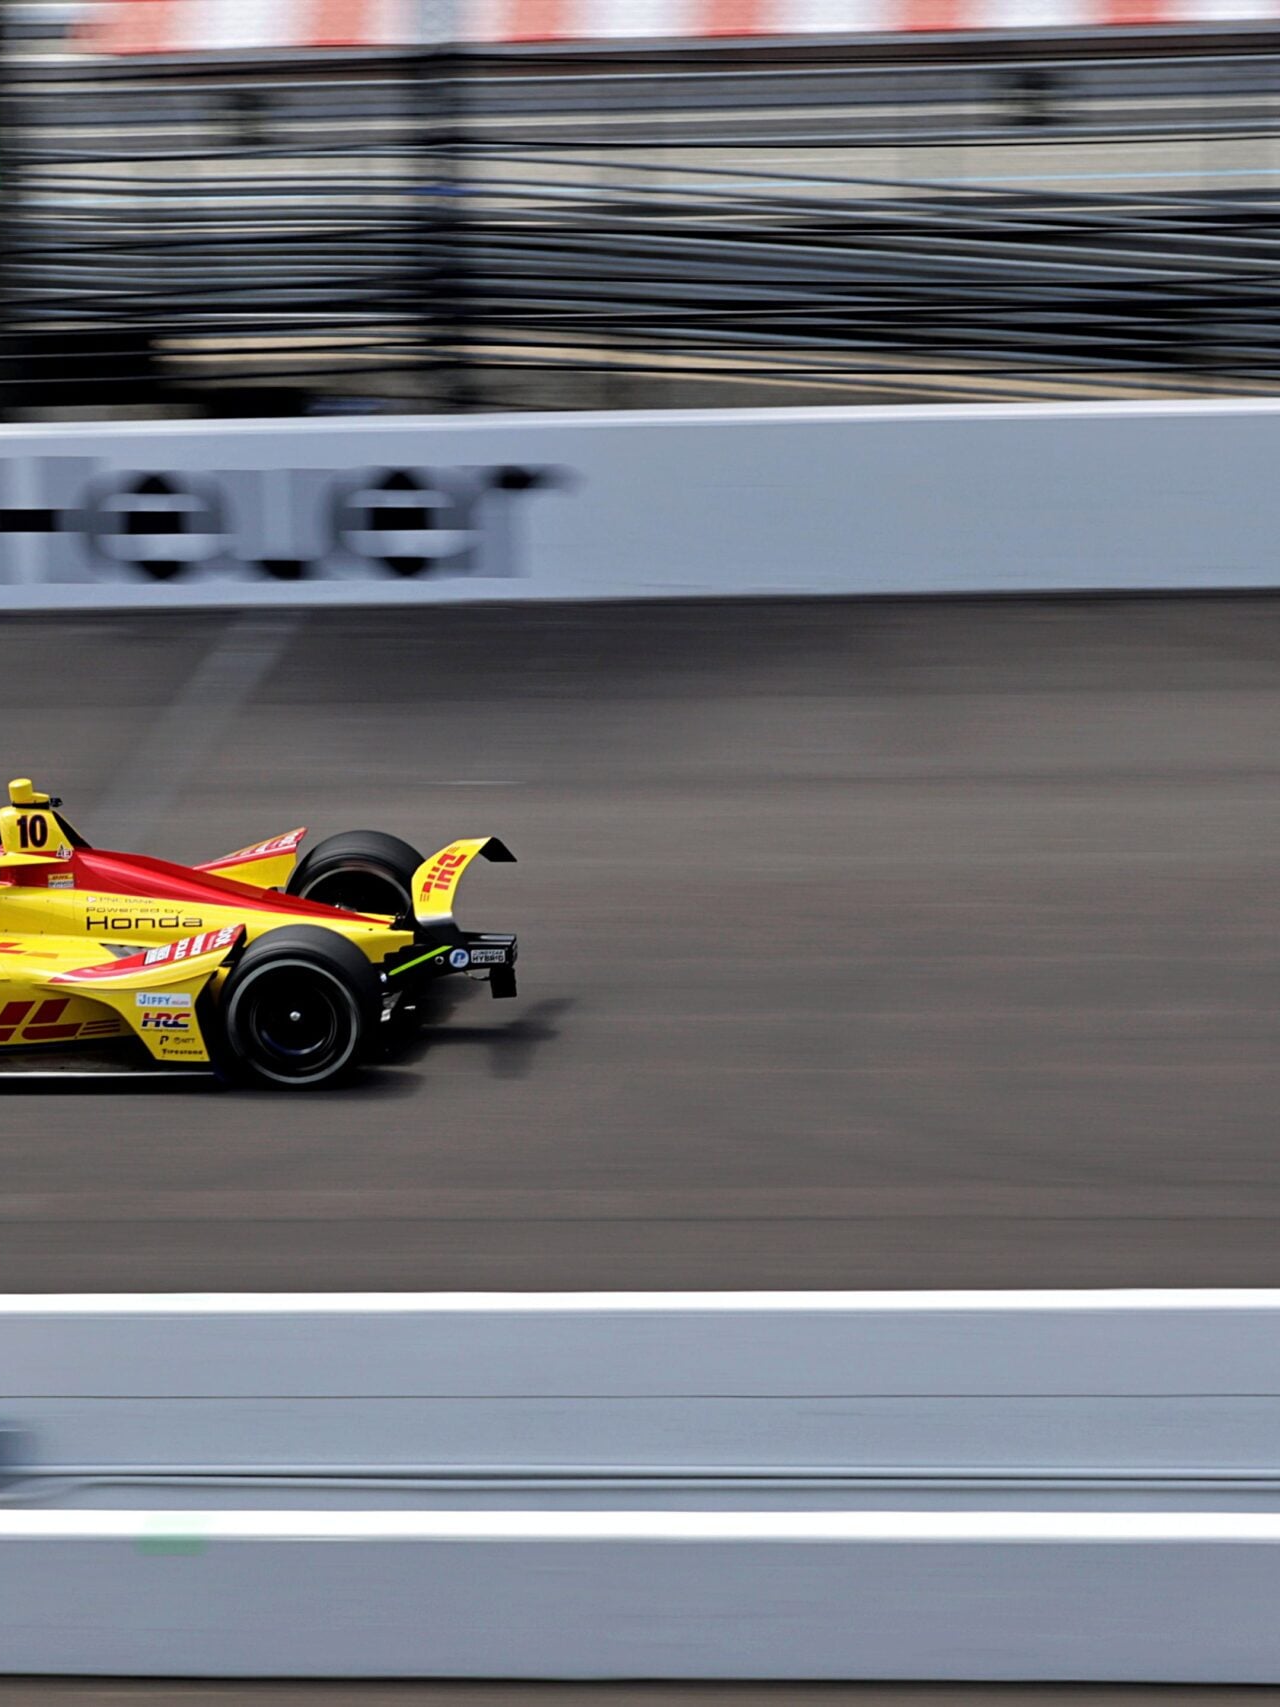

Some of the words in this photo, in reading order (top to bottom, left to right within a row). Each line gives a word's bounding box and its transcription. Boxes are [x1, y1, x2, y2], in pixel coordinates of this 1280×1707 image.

[17, 814, 48, 848] 10
[423, 853, 468, 893] DHL
[86, 915, 203, 930] Honda
[139, 994, 171, 1005] JIFFY
[142, 1012, 192, 1028] HRC
